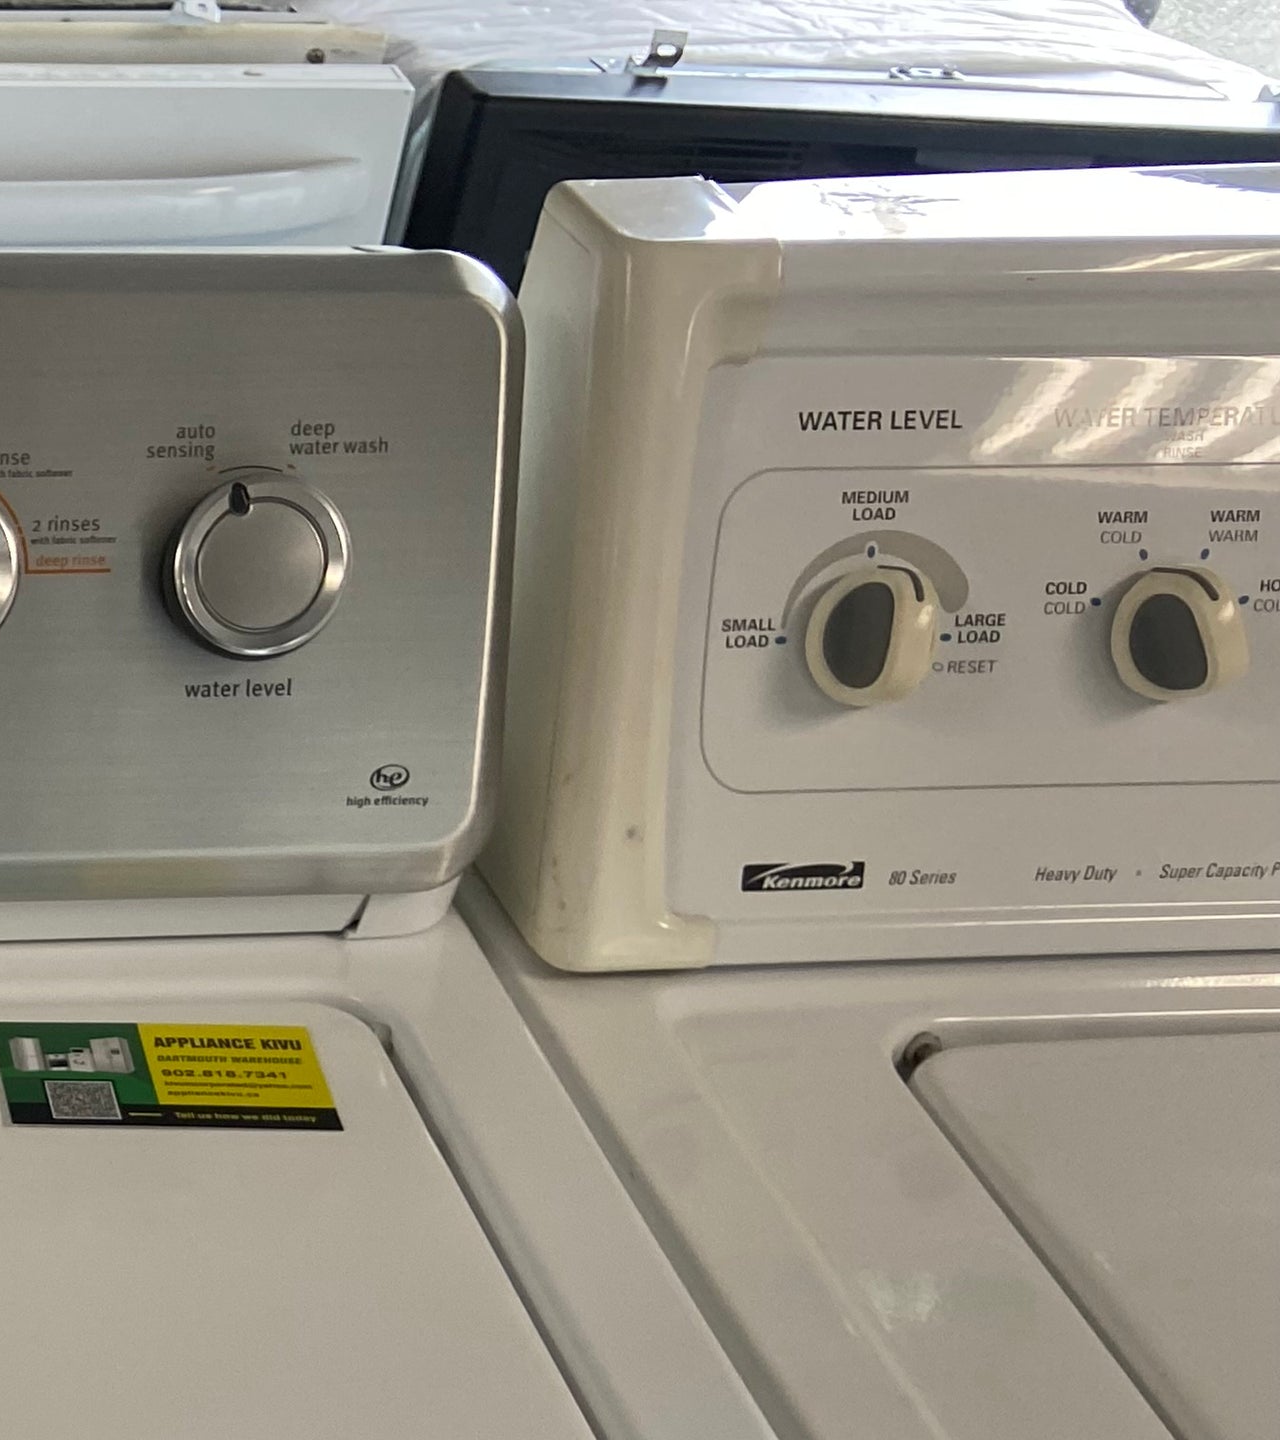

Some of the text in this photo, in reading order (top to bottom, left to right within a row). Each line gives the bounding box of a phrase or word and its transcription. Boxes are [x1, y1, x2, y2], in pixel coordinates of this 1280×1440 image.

[798, 410, 963, 432] WATER LEVEL
[1054, 407, 1136, 427] WATER
[176, 424, 215, 441] auto
[290, 420, 335, 440] deep
[146, 440, 215, 461] sensing
[289, 437, 389, 456] water wash
[1162, 447, 1202, 458] RINSE
[841, 490, 910, 504] MEDIUM
[852, 508, 896, 521] LOAD
[1098, 511, 1148, 523] WARM
[1210, 510, 1260, 522] WARM
[32, 516, 101, 532] 2 rinses
[1100, 531, 1142, 543] COLD
[1209, 530, 1258, 542] WARM
[35, 554, 106, 568] deep rinse
[1045, 582, 1087, 594] COLD
[1044, 602, 1085, 614] COLD
[721, 619, 776, 632] SMALL
[954, 614, 1006, 627] LARGE
[725, 634, 769, 648] LOAD
[957, 630, 1001, 644] LOAD
[947, 660, 997, 673] RESET
[185, 679, 292, 700] water level
[346, 795, 429, 808] high efficiency
[889, 867, 957, 884] 80 Series
[1034, 865, 1117, 882] Heavy Duty
[1159, 864, 1203, 881] Super
[1206, 862, 1268, 879] Capacity
[762, 873, 861, 889] Kenmore
[154, 1036, 302, 1051] APPLIANCE KIVU
[157, 1055, 302, 1065] DARTMOUTH WAREHOUSE
[174, 1111, 195, 1119] Tell
[214, 1112, 240, 1121] how
[261, 1113, 281, 1121] did
[283, 1114, 317, 1123] today
